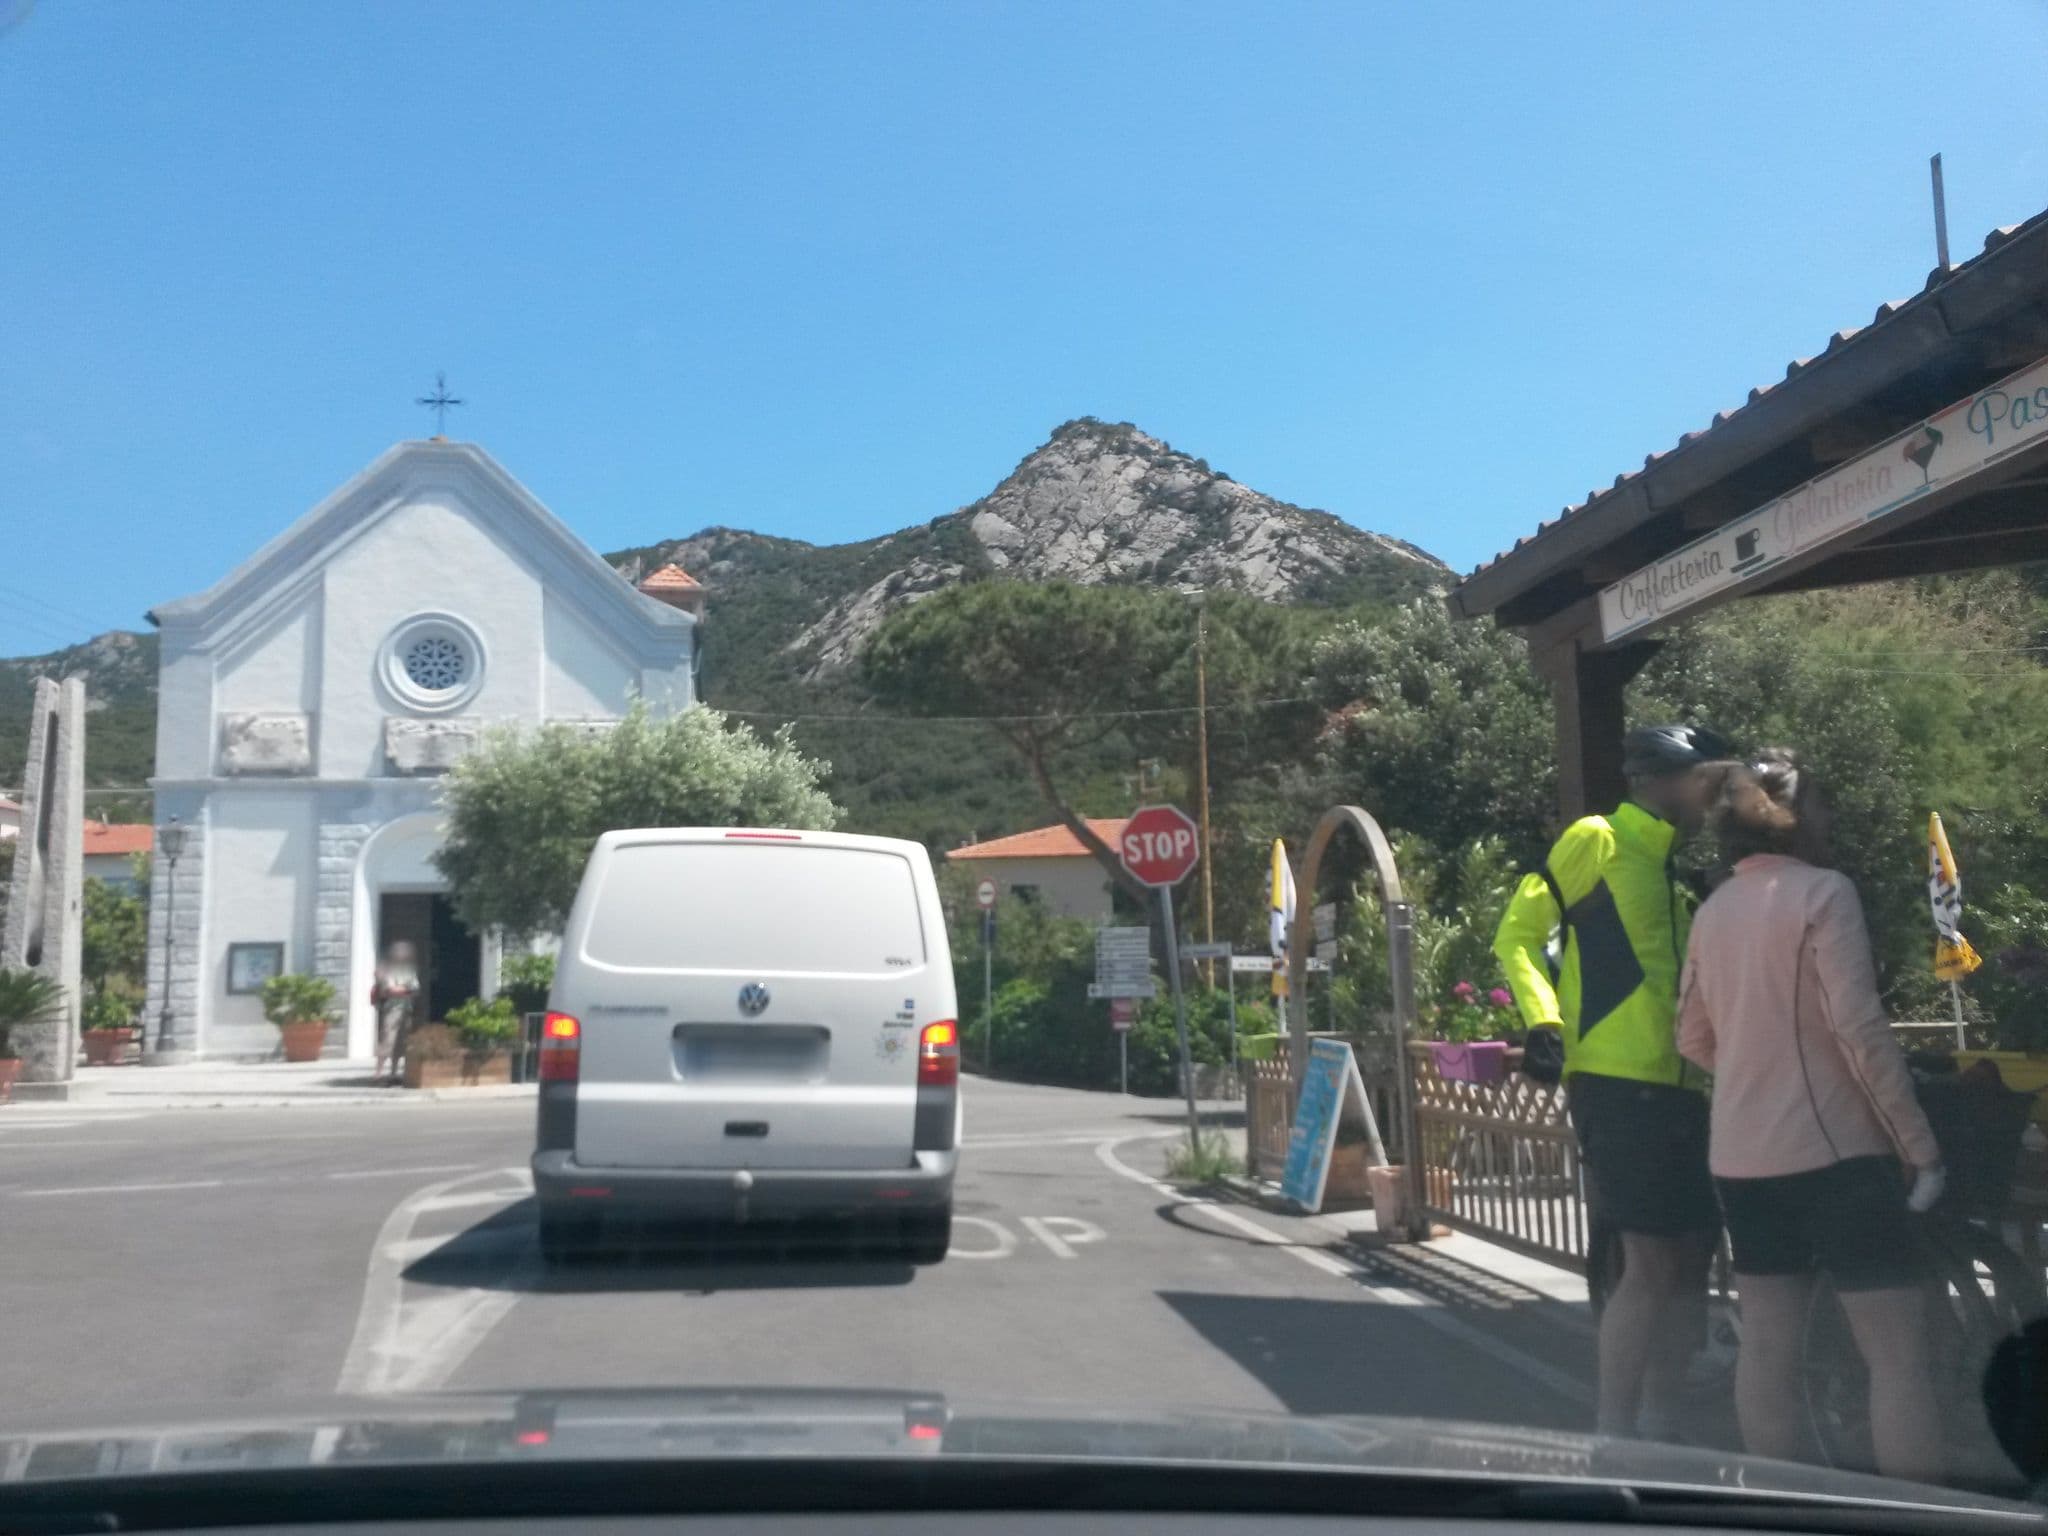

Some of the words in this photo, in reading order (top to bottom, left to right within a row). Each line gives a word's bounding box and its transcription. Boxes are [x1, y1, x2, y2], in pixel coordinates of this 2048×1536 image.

[1620, 551, 1724, 620] Caffetteria
[1774, 464, 1894, 555] Gelateria
[1125, 829, 1191, 864] STOP
